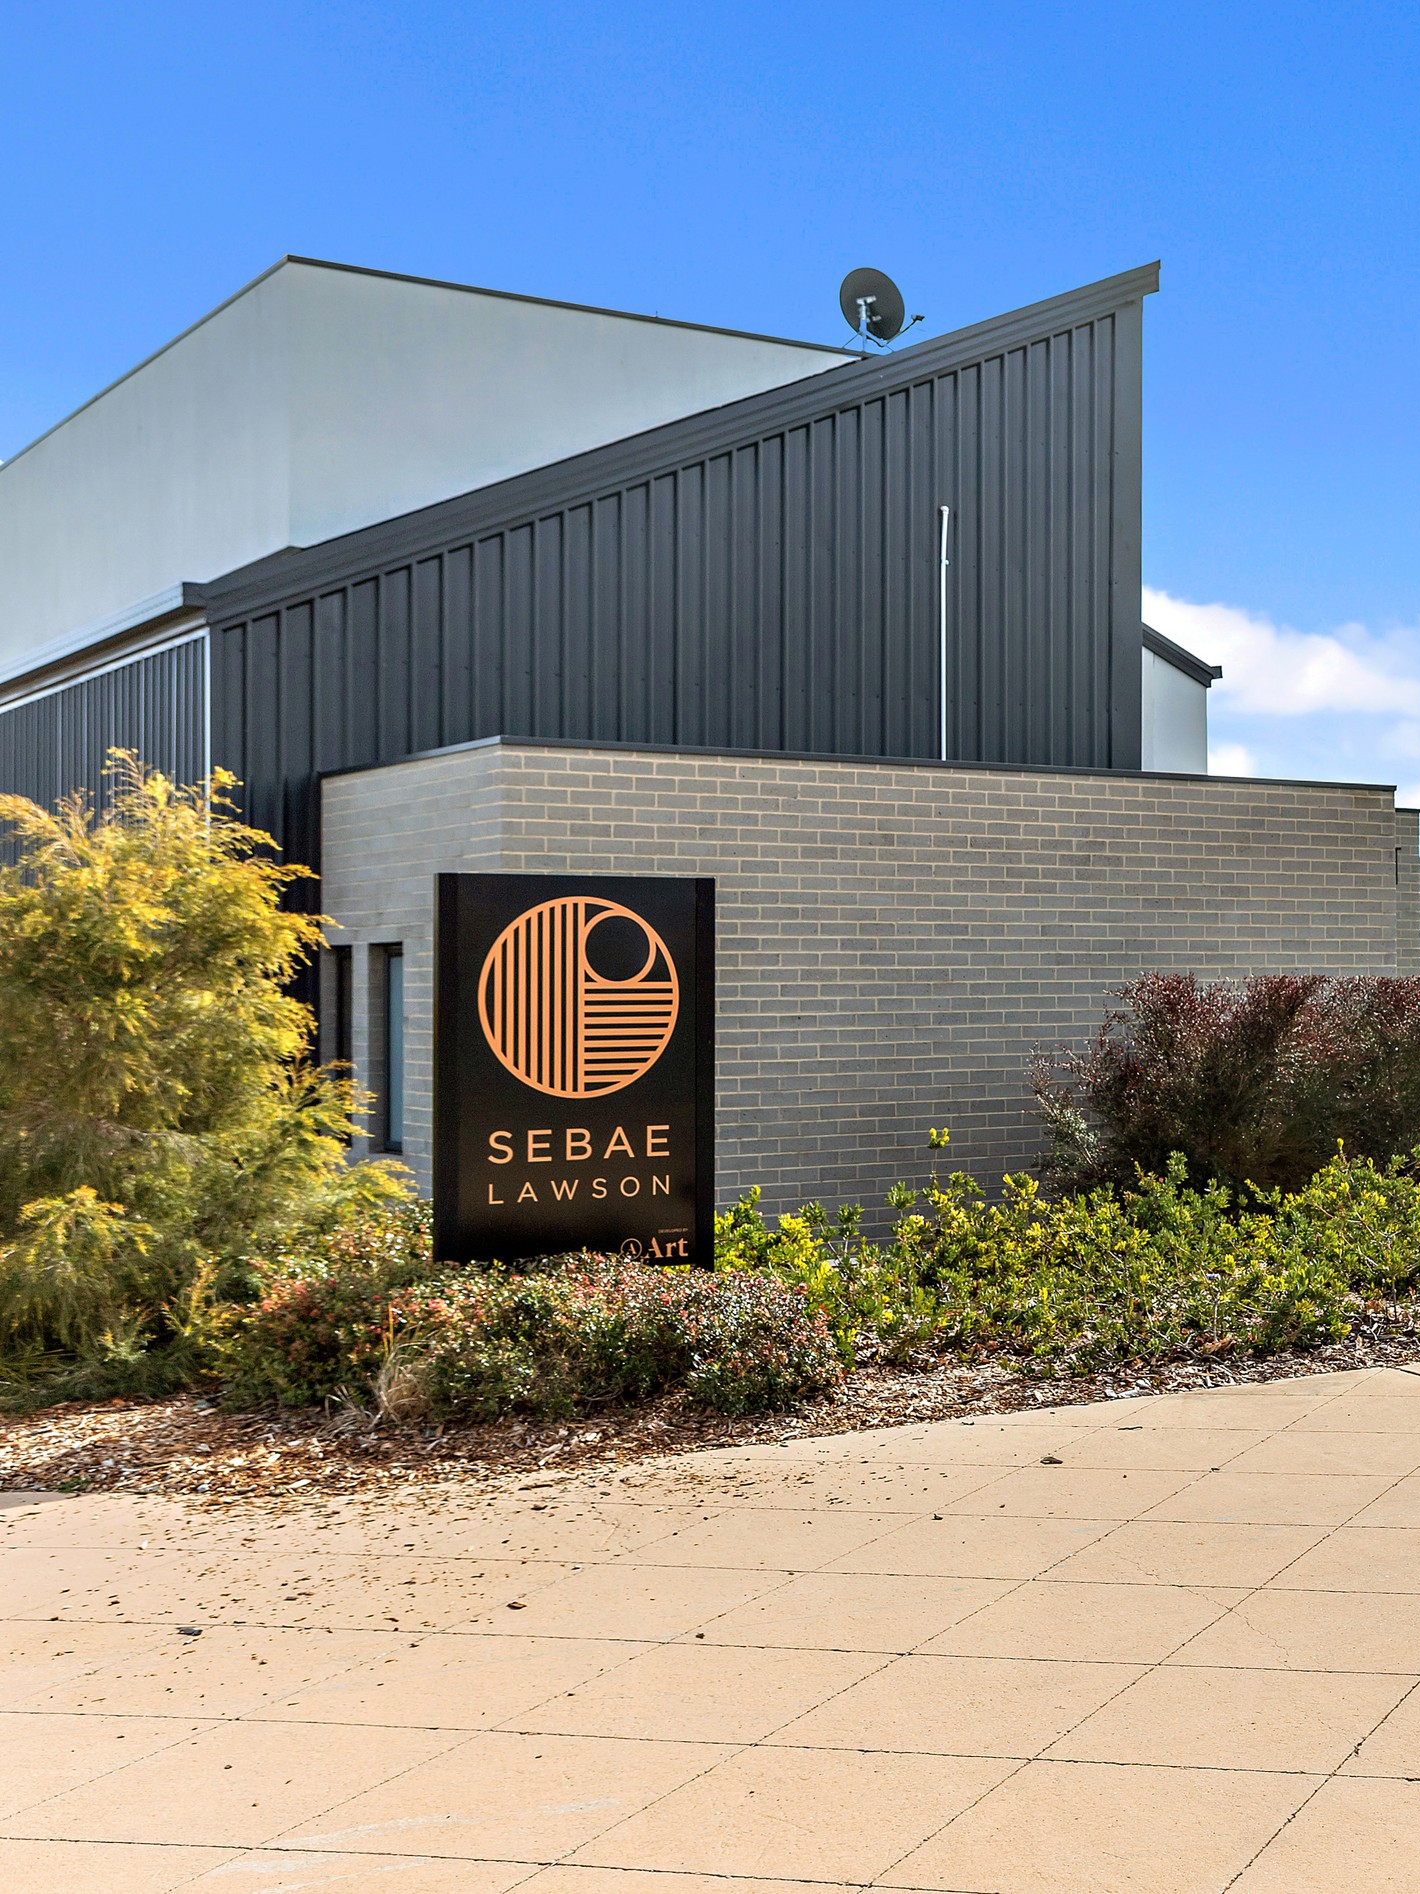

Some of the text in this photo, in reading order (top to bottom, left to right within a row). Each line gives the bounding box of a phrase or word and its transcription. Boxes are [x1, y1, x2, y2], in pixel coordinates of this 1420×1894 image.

[488, 1125, 670, 1164] SEBAE
[488, 1175, 670, 1205] LAWSON
[644, 1237, 689, 1258] Art
